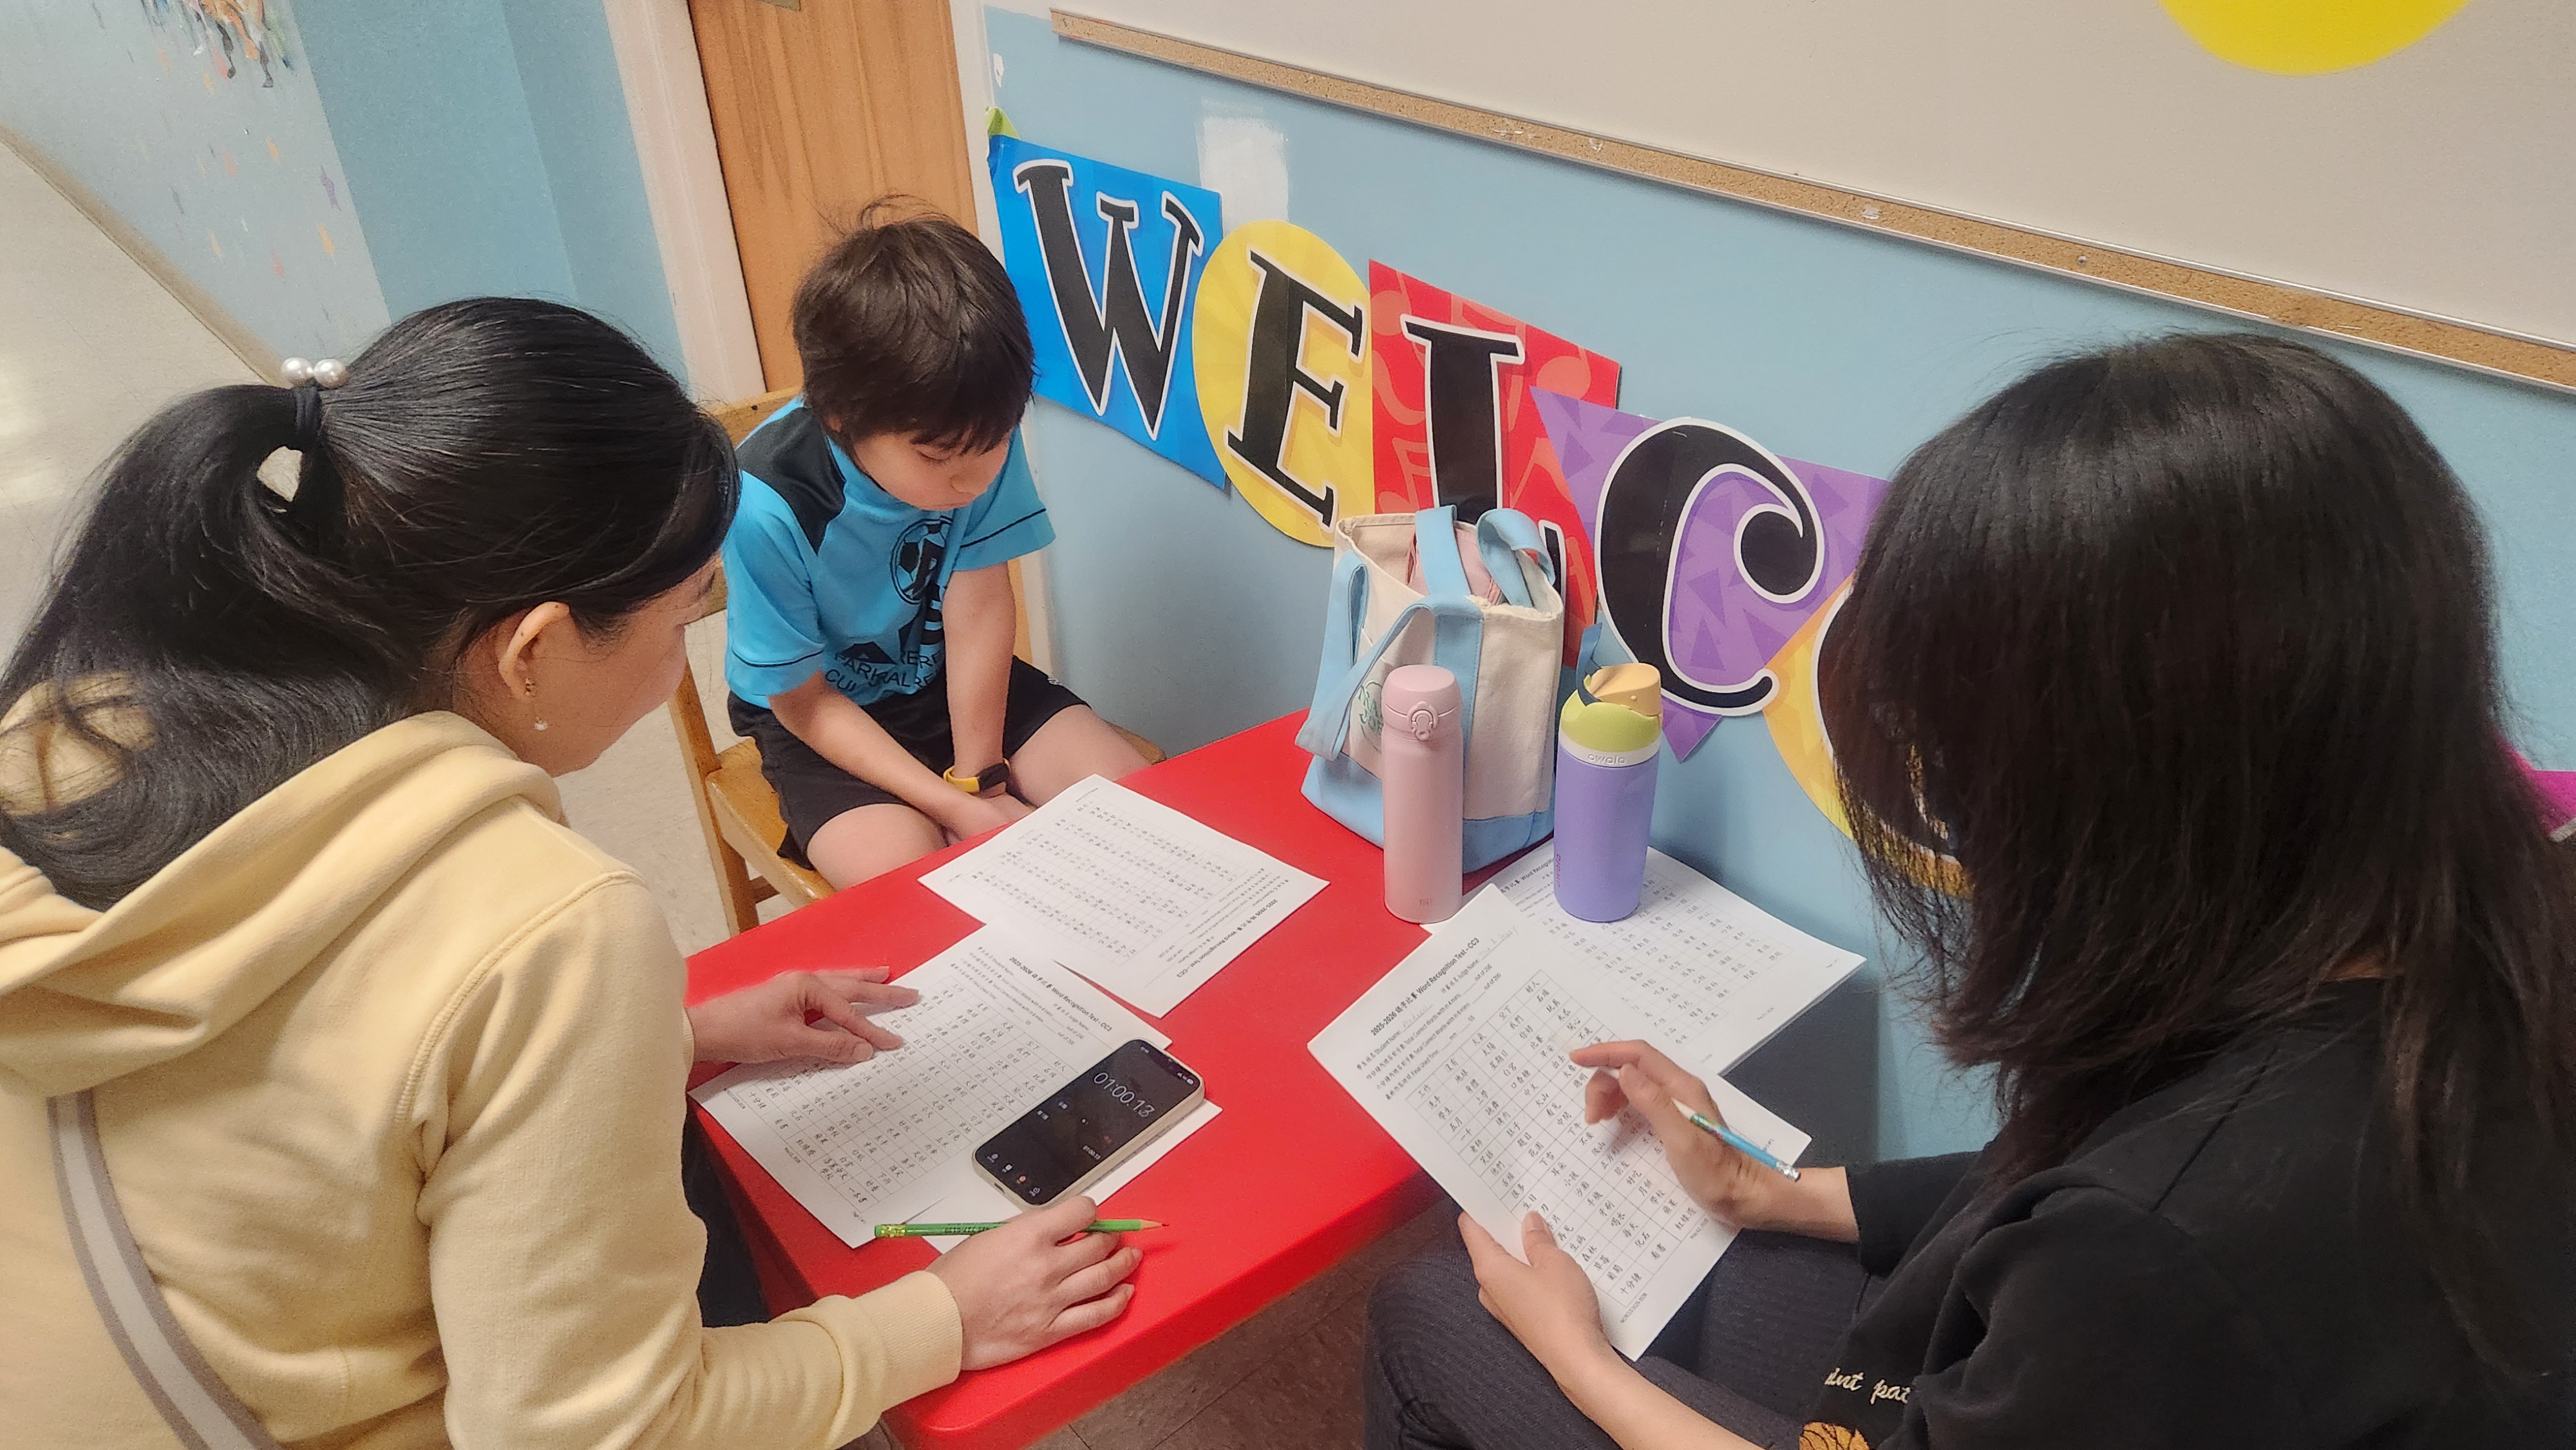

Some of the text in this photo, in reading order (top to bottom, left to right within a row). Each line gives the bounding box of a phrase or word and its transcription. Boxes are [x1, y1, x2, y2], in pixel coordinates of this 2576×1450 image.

[1061, 994, 1091, 1017] Recognition
[1099, 1022, 1113, 1031] CC3
[1175, 968, 1189, 977] CC3
[1369, 1010, 1397, 1036] 2025-2026
[1416, 980, 1432, 994] Word
[1428, 957, 1459, 984] Recognition
[1454, 948, 1467, 960] Test
[1466, 937, 1480, 949] CC3
[1373, 1039, 1391, 1055] Student
[1412, 1022, 1428, 1038] Correct
[1416, 1083, 1432, 1099] 工作
[1497, 1004, 1513, 1020] 坐下
[1524, 979, 1540, 994] 好人
[1446, 1116, 1463, 1133] 五月
[1473, 1088, 1490, 1106] 上學
[1528, 1033, 1545, 1050] 比賽
[1555, 1006, 1572, 1022] 木瓜
[1480, 1041, 1497, 1057] 太陽
[1508, 1014, 1524, 1030] 我們
[1094, 1072, 1155, 1118] 01:00.13
[1435, 1104, 1454, 1121] 學生
[1463, 1078, 1480, 1093] 身體
[1488, 1049, 1510, 1070] 星期日
[1517, 1024, 1535, 1040] 你好
[1457, 1126, 1474, 1143] 一千
[1509, 1068, 1531, 1090] 口香糖
[1539, 1043, 1556, 1059] 早安
[1566, 1016, 1582, 1031] 開心
[1467, 1137, 1484, 1154] 老師
[1522, 1081, 1539, 1097] 中文
[1549, 1053, 1567, 1069] 出去
[1577, 1026, 1593, 1041] 不是
[1544, 1100, 1562, 1118] 看見
[1571, 1072, 1588, 1089] 聰明
[1479, 1063, 1578, 1165] 笑話 肚子 火山 大象
[1499, 1111, 1572, 1187] 舌頭 花園 中間
[1510, 1120, 1584, 1200] 很多 下雪 下午
[1520, 1193, 1537, 1210] 生日
[1578, 1130, 1595, 1147] 不要
[1562, 1170, 1579, 1187] 小孩
[1573, 1180, 1591, 1198] 沙灘
[1598, 1145, 1621, 1169] 正方形
[1555, 1222, 1575, 1242] 再見
[1613, 1159, 1630, 1176] 朋友
[1567, 1168, 1642, 1252] 生病 牙刷 好吃
[1580, 1243, 1598, 1262] 森林
[1608, 1210, 1627, 1229] 喝水
[1593, 1188, 1666, 1272] 草莓 每天 學校
[1633, 1230, 1651, 1248] 化石
[1662, 1197, 1678, 1215] 蘋果
[1618, 1205, 1696, 1297] 十分鐘 看書 紅綠燈
